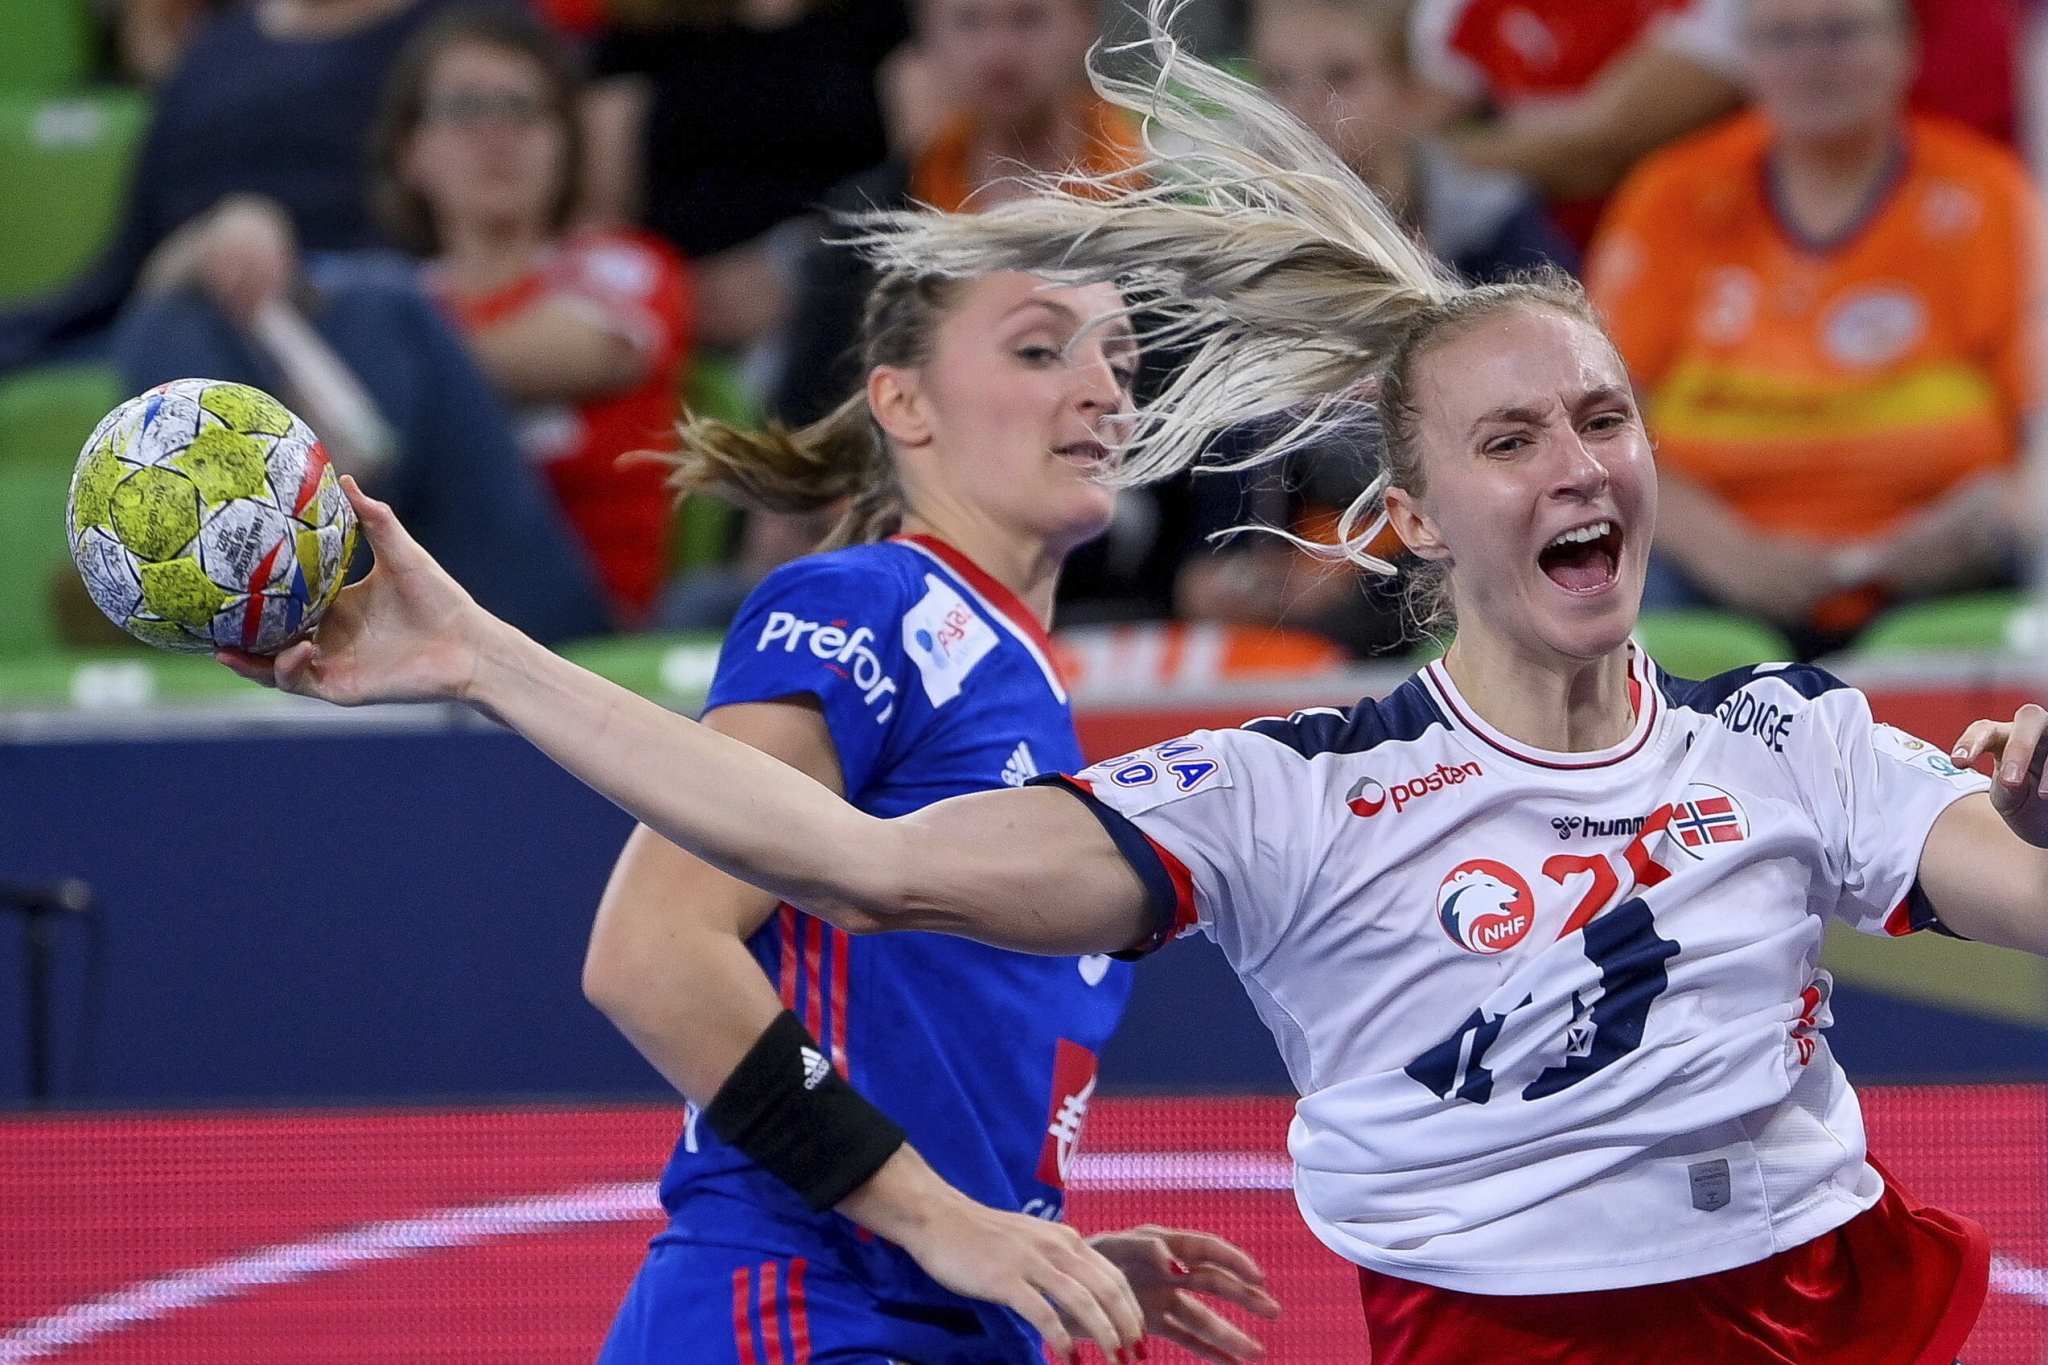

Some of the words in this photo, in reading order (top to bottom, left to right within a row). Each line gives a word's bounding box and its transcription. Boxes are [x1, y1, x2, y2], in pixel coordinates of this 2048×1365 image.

[756, 611, 897, 724] Préfon
[1152, 737, 1218, 791] MA
[1390, 761, 1483, 813] posten
[1582, 815, 1650, 838] humm
[1484, 916, 1525, 944] NHF
